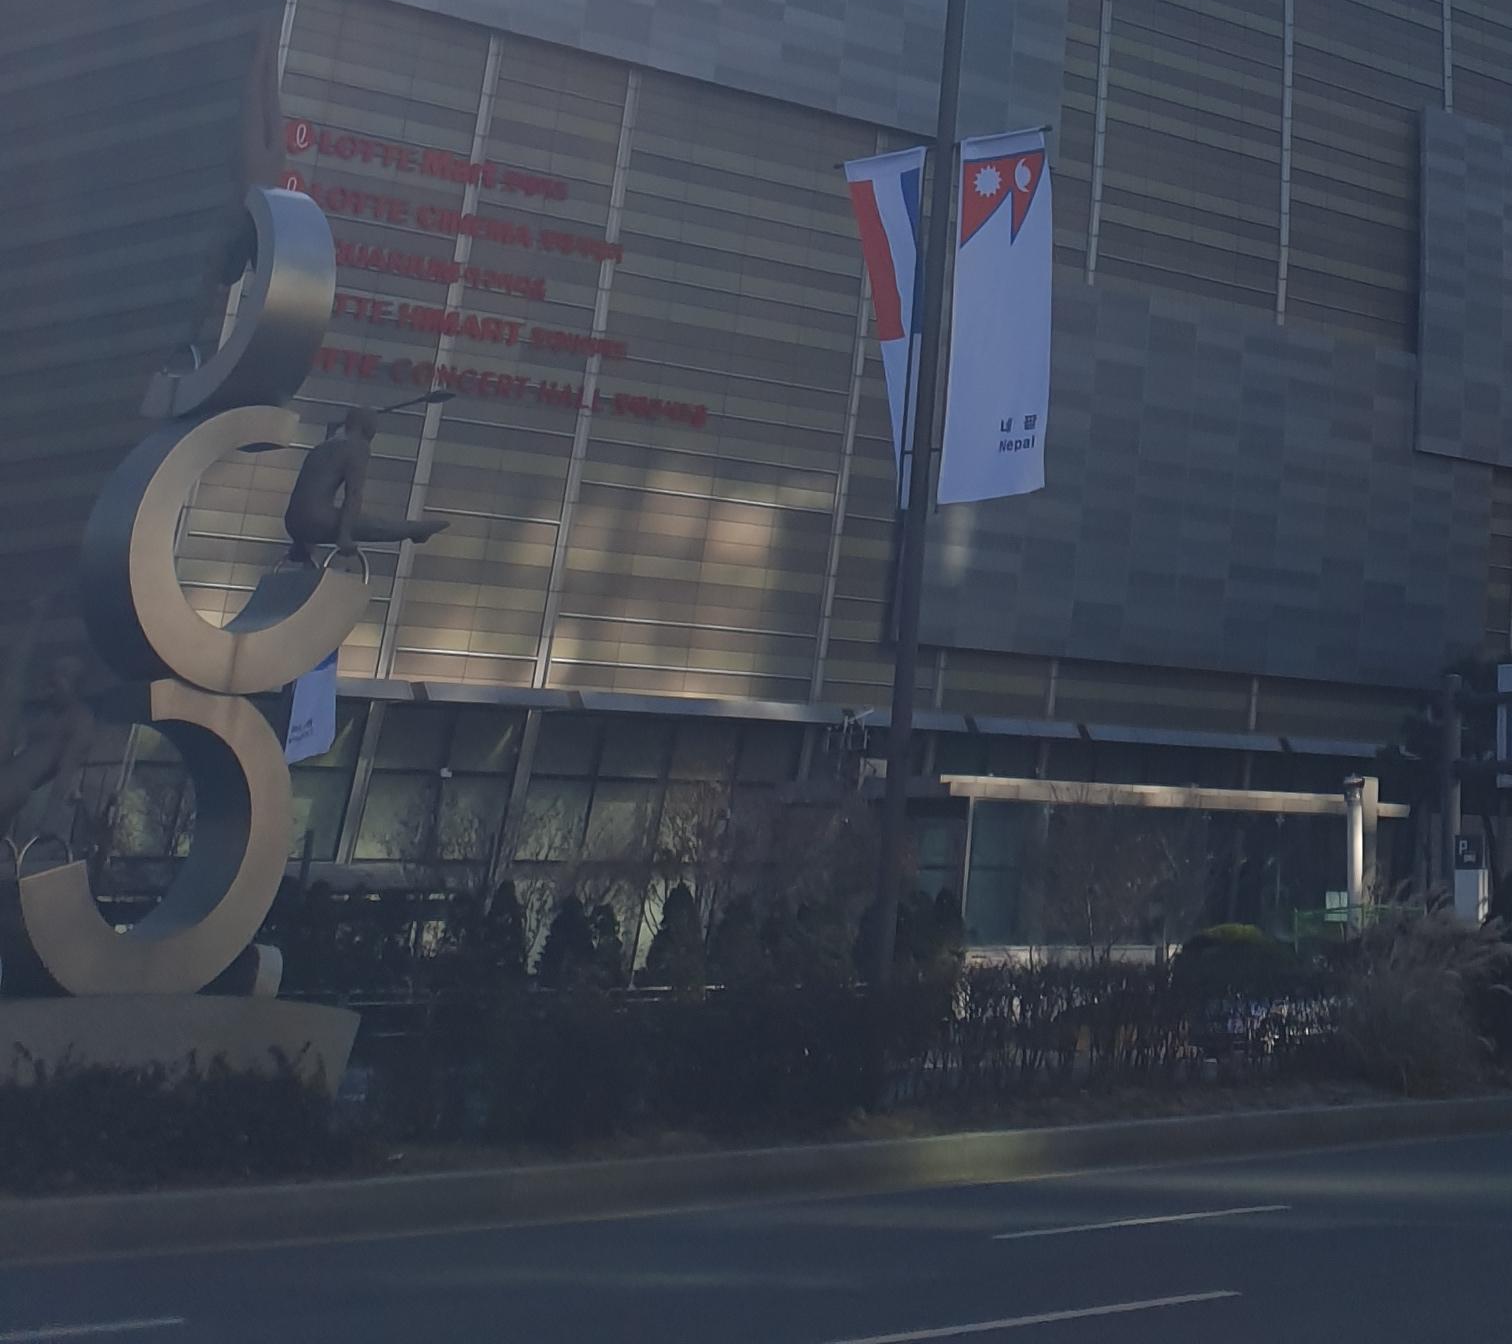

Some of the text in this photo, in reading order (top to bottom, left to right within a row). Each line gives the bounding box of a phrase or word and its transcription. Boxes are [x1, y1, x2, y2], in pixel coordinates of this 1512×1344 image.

[318, 129, 420, 172] LOTTE
[311, 182, 408, 223] LOTTE
[336, 240, 460, 285] QUARIUM
[335, 294, 399, 324] TTE
[312, 346, 384, 378] TTE
[391, 356, 529, 400] CONCERT
[998, 435, 1036, 453] Nepal
[1458, 840, 1469, 855] P
